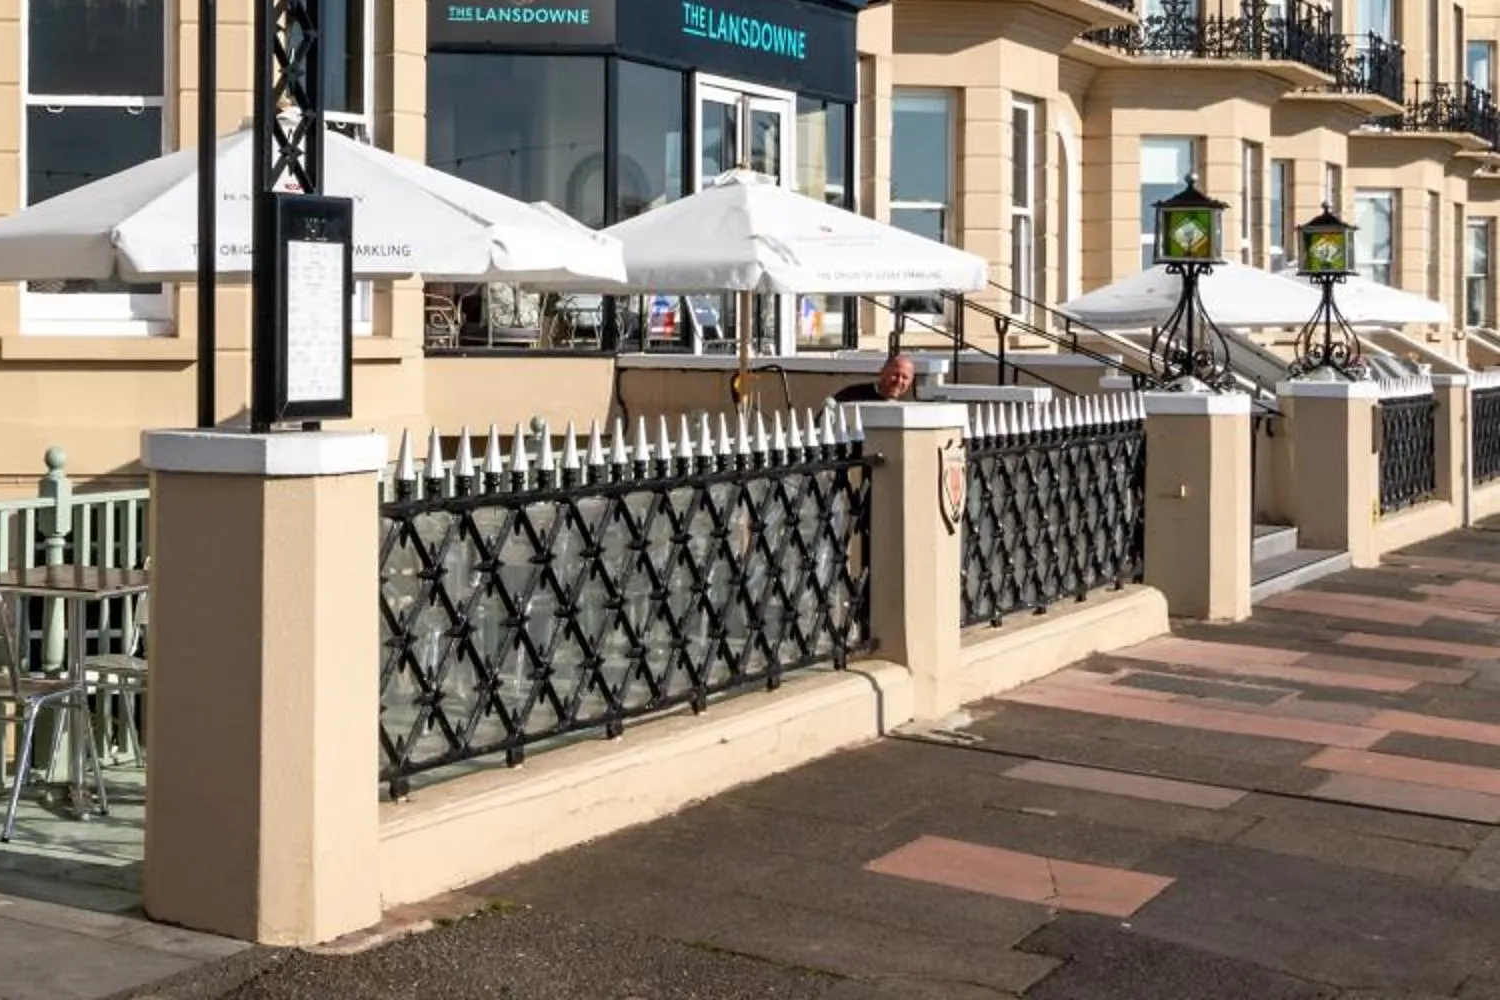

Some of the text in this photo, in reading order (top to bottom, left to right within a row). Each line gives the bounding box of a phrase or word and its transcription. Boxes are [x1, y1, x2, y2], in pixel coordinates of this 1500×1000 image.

[449, 6, 590, 25] THE LANSDOWNE
[683, 1, 805, 59] THE LANSDOWNE
